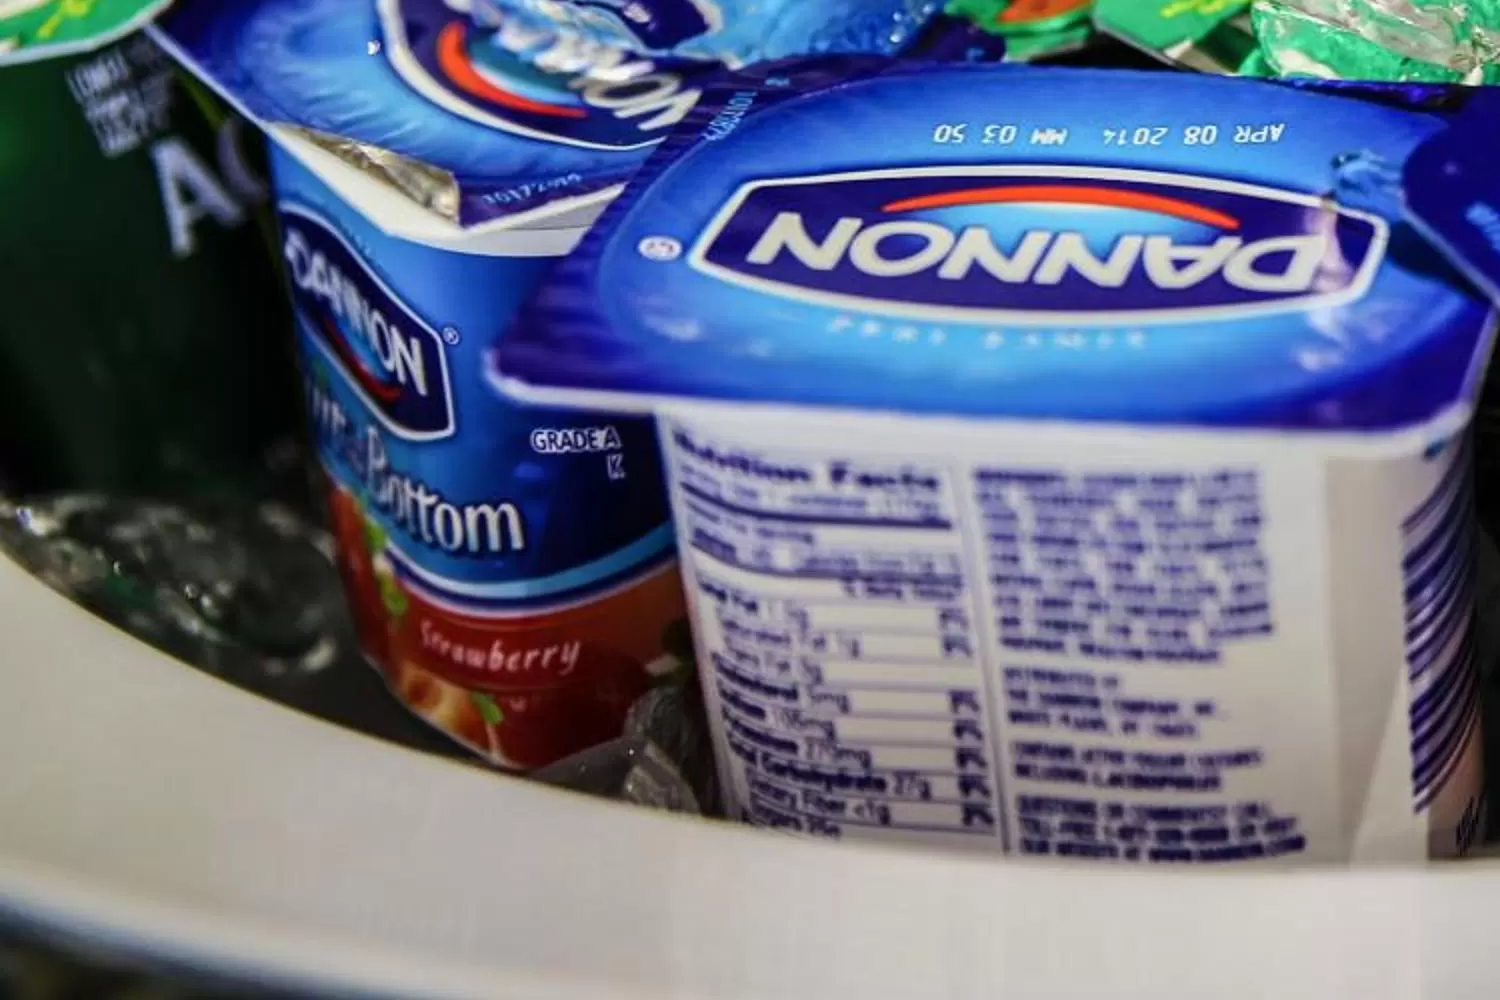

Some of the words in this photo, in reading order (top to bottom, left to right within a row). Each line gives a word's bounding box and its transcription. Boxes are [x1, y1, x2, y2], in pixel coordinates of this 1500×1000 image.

[932, 122, 969, 144] 50
[981, 123, 1018, 145] 03
[1102, 126, 1170, 146] 2014
[1182, 123, 1219, 146] 08
[1232, 122, 1286, 144] APR
[747, 210, 1331, 293] DANNON
[284, 226, 429, 397] DANNON
[531, 428, 599, 454] GRADE
[602, 426, 623, 449] A
[366, 424, 525, 554] Bottom
[418, 618, 582, 676] Strawberry
